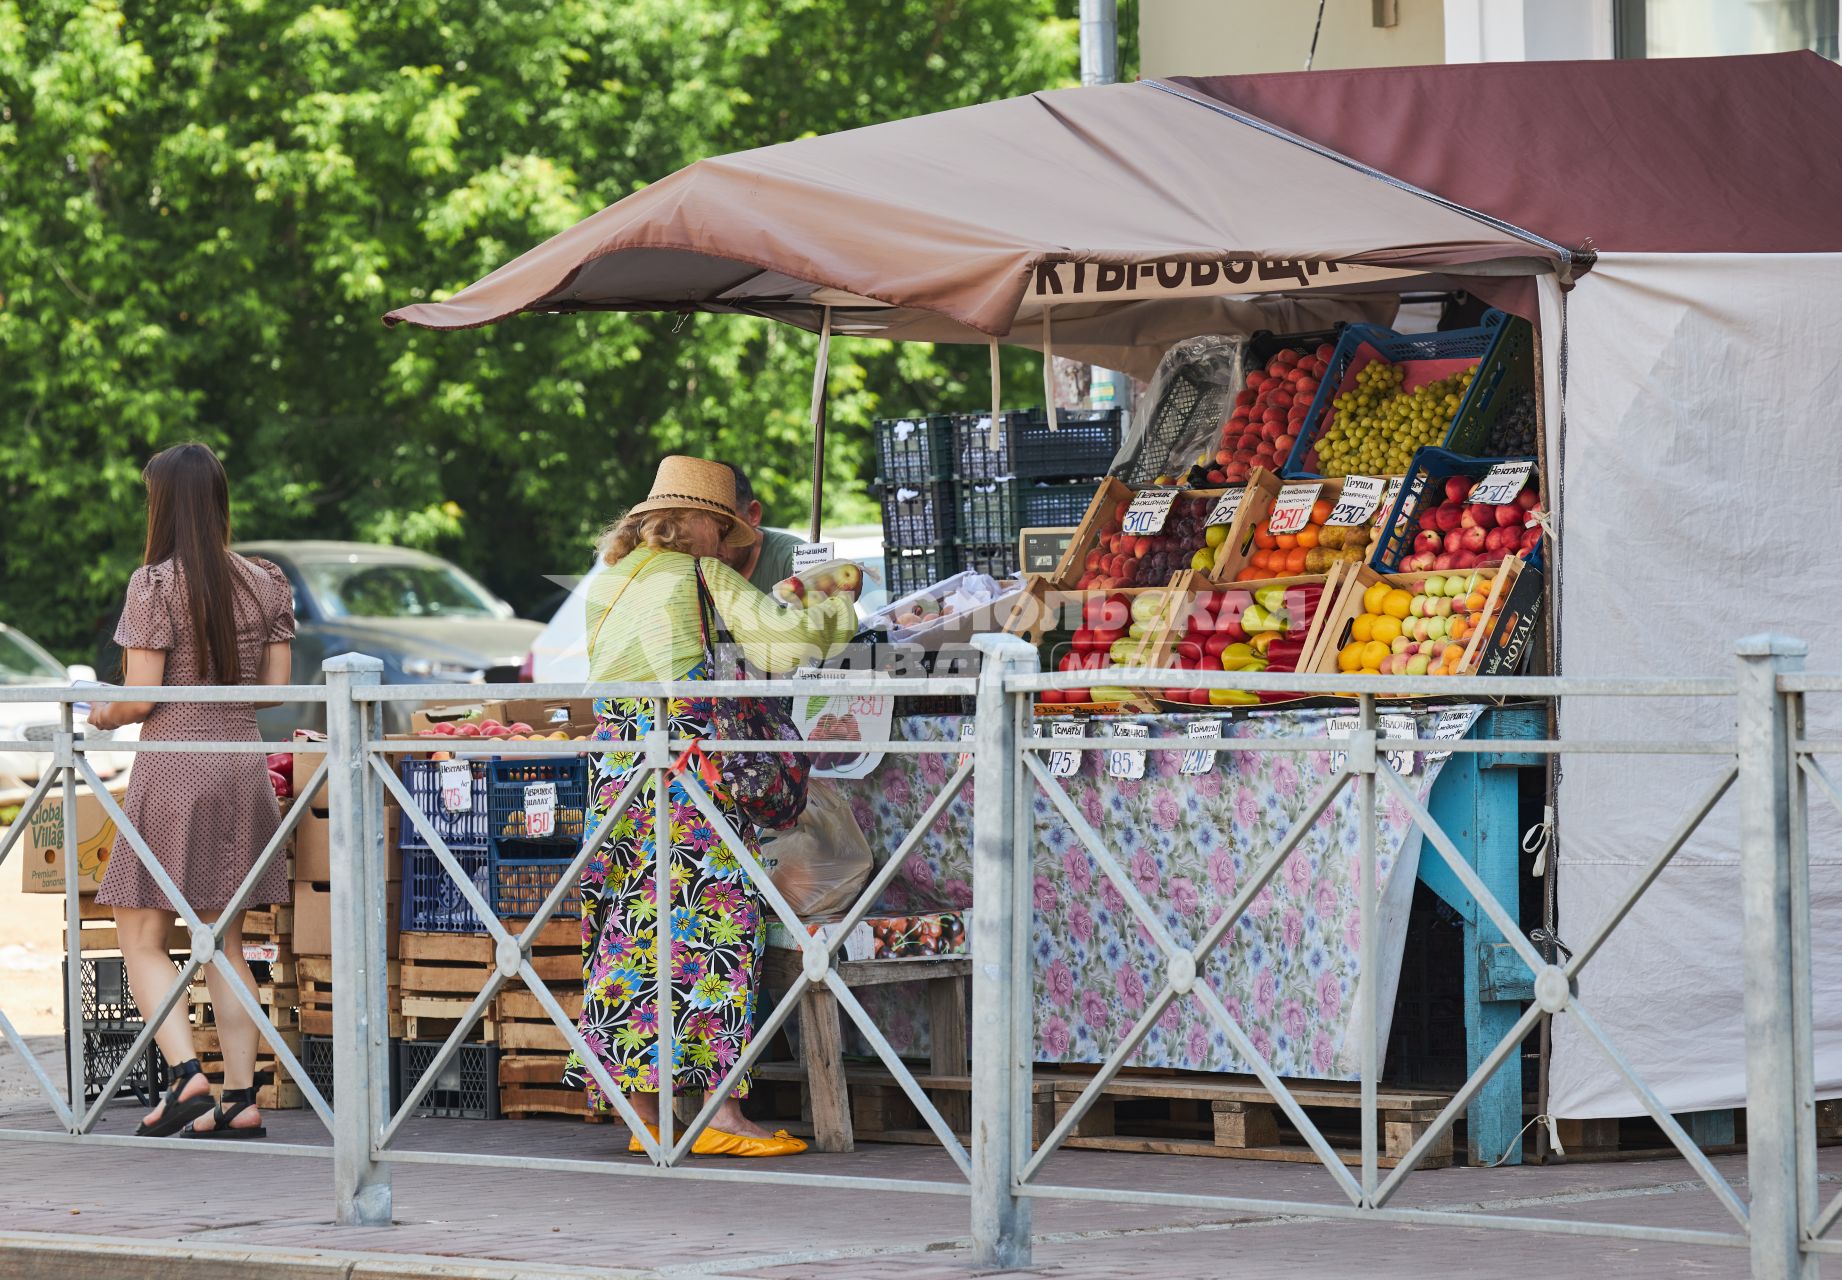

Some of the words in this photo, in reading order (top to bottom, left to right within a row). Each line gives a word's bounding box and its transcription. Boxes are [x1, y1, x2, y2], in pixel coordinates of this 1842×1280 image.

[1502, 614, 1534, 670] ROYAL
[1330, 719, 1360, 730] Лимо
[32, 826, 65, 849] Villag
[32, 868, 58, 879] Premium
[42, 877, 65, 888] banana
